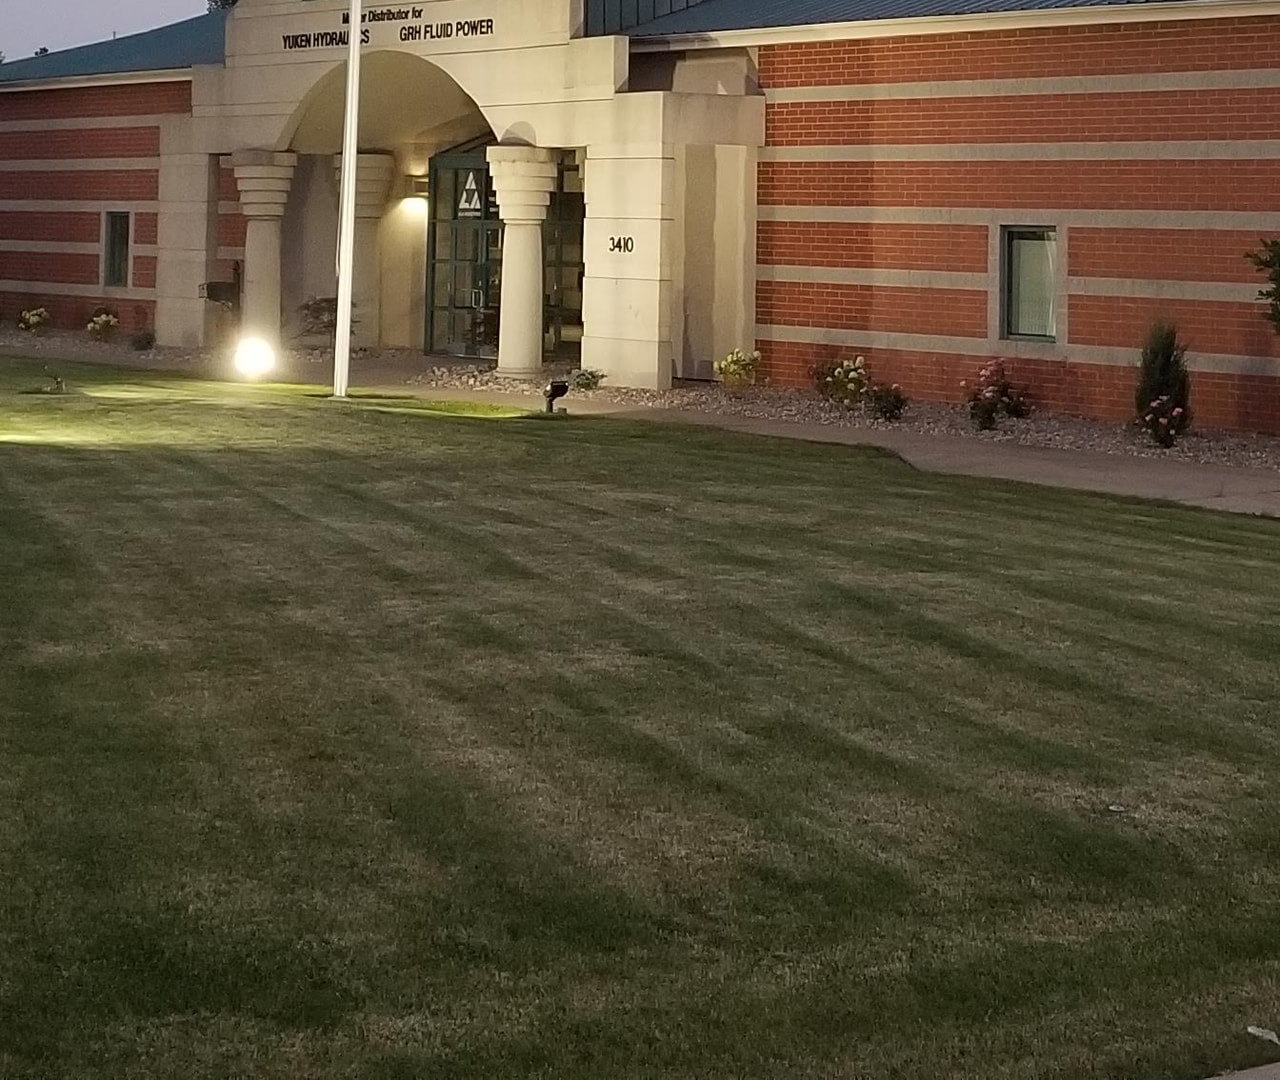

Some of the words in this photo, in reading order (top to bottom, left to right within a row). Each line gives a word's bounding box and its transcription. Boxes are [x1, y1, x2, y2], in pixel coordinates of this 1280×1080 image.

[368, 8, 410, 22] Distributor
[411, 6, 423, 19] for
[400, 24, 421, 41] GRH
[424, 22, 453, 39] FLUID
[456, 18, 493, 37] POWER
[282, 33, 311, 49] YUKEN
[609, 236, 634, 253] 3410
